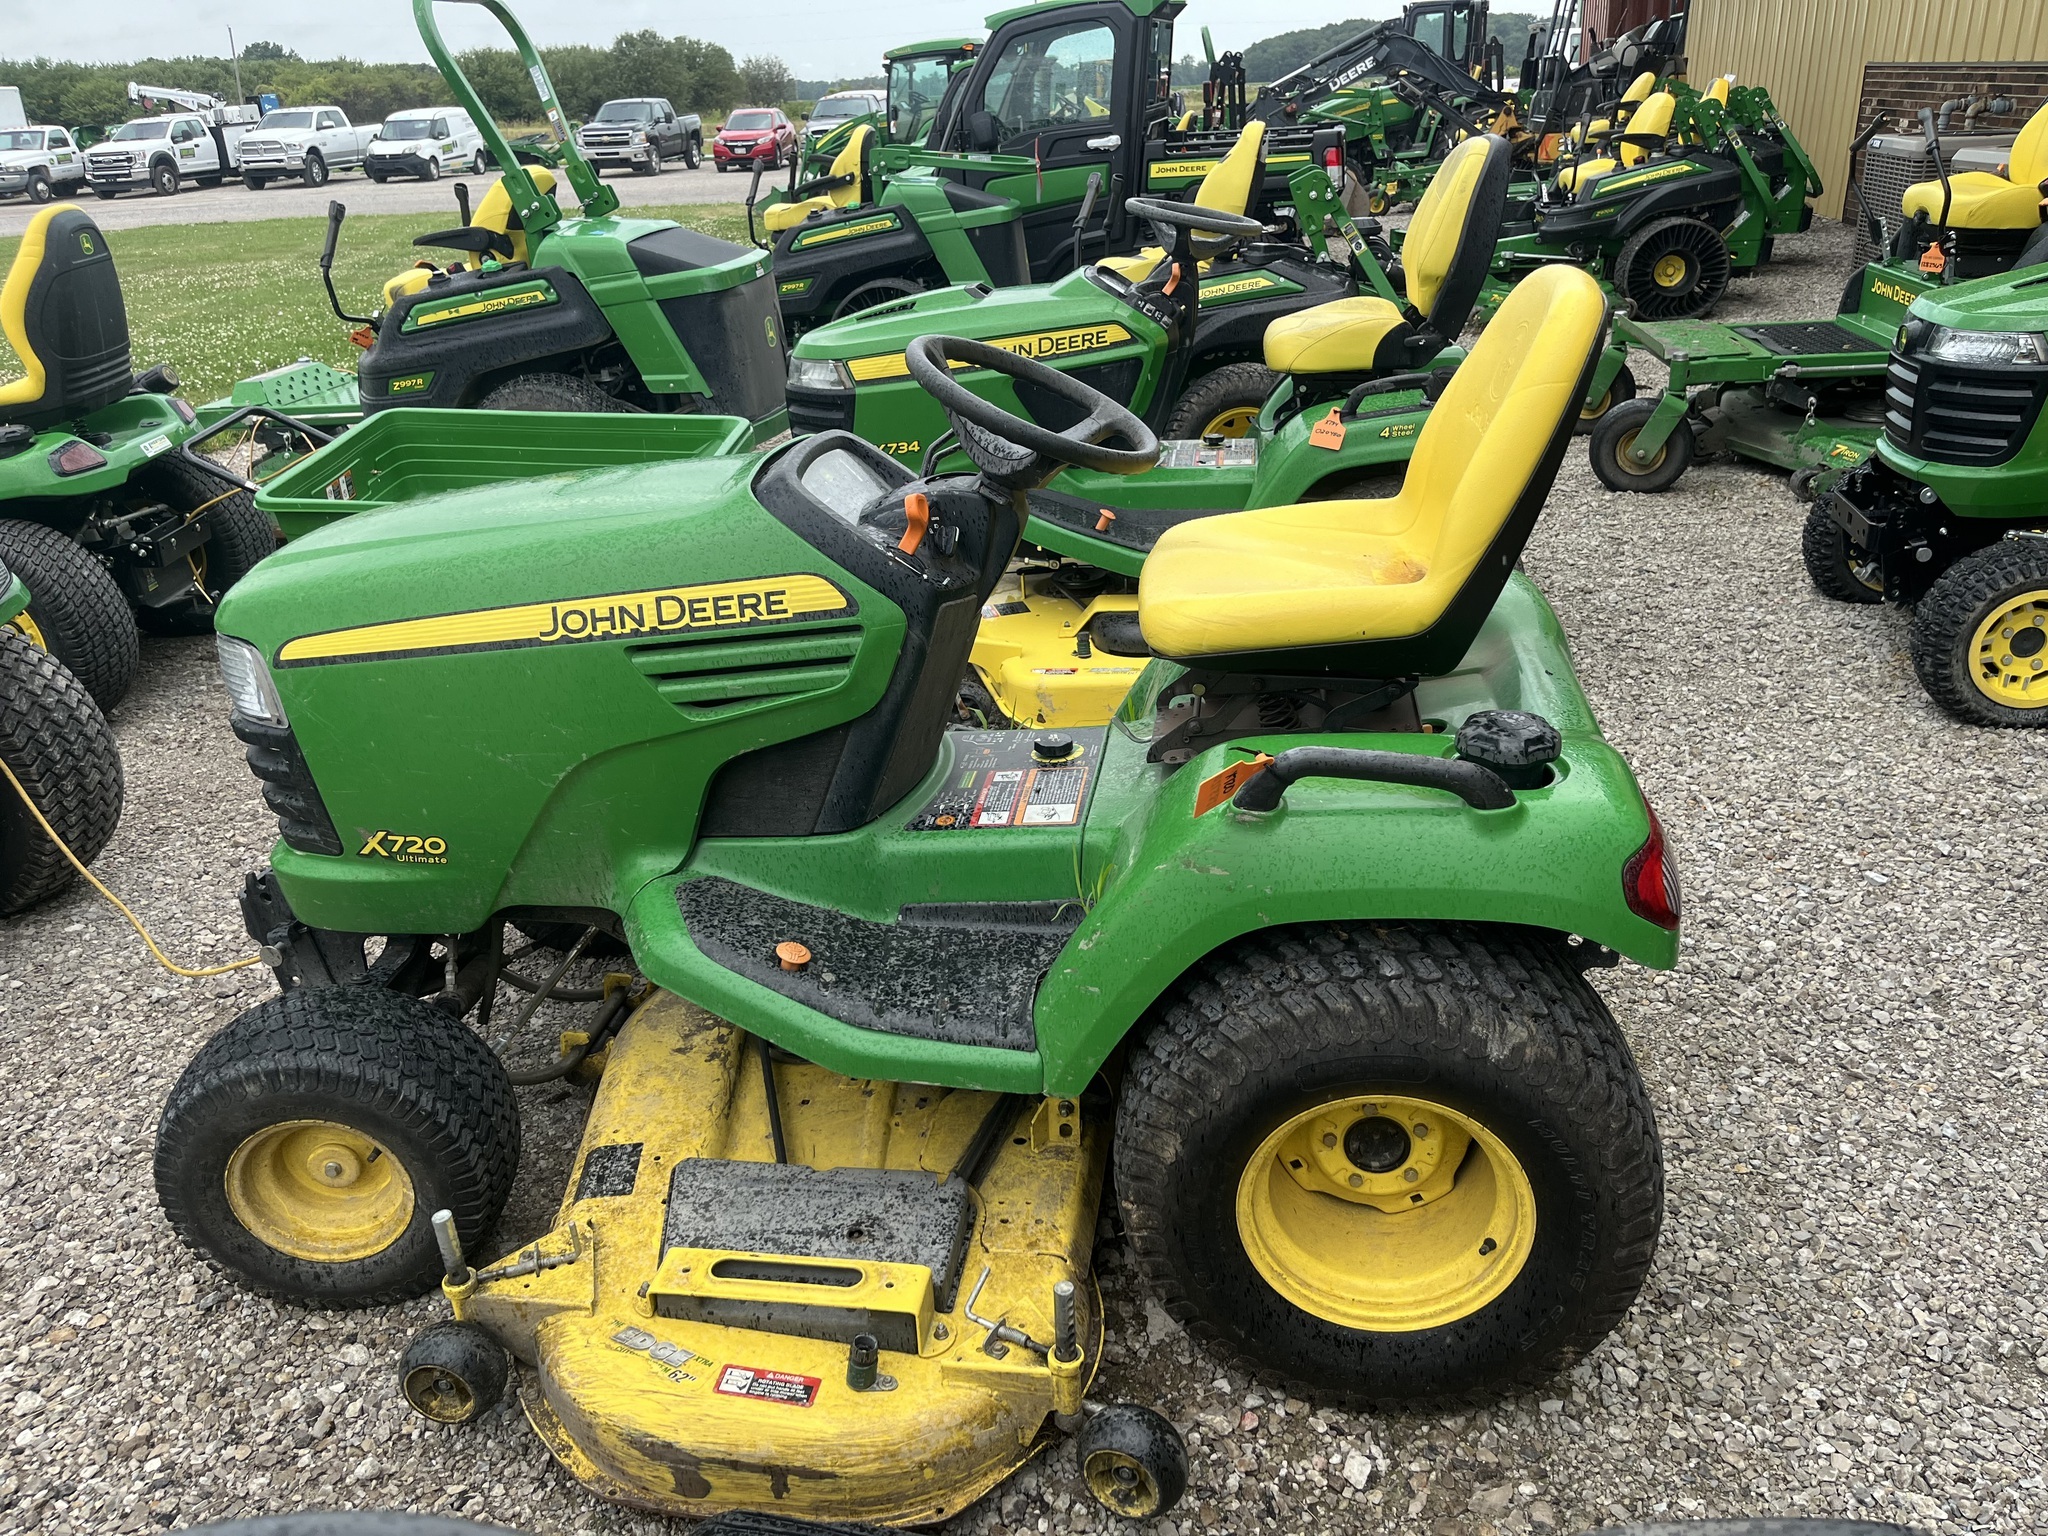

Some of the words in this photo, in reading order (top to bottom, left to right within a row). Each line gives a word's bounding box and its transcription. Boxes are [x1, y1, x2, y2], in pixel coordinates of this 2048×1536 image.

[1328, 56, 1377, 92] DEERE
[1155, 166, 1177, 174] JOHN
[1179, 165, 1207, 173] DEERE
[848, 227, 865, 236] JOHN
[866, 221, 888, 232] DEERE
[1199, 286, 1226, 298] JOHN
[1227, 280, 1262, 292] DEERE
[1871, 278, 1894, 299] JOHN
[481, 301, 506, 313] JOHN
[1038, 330, 1108, 354] DEERE
[393, 378, 424, 391] Z997R
[1379, 427, 1391, 439] 4
[1391, 423, 1416, 431] Wheel
[1391, 429, 1414, 438] Steer
[540, 604, 646, 638] JOHN
[655, 589, 790, 627] DEERE
[358, 830, 448, 857] X720
[396, 854, 448, 864] Ultimate
[610, 1325, 697, 1369] EDGE
[695, 1355, 714, 1368] XTRA
[667, 1369, 697, 1384] 62"
[774, 1373, 805, 1383] DANGER
